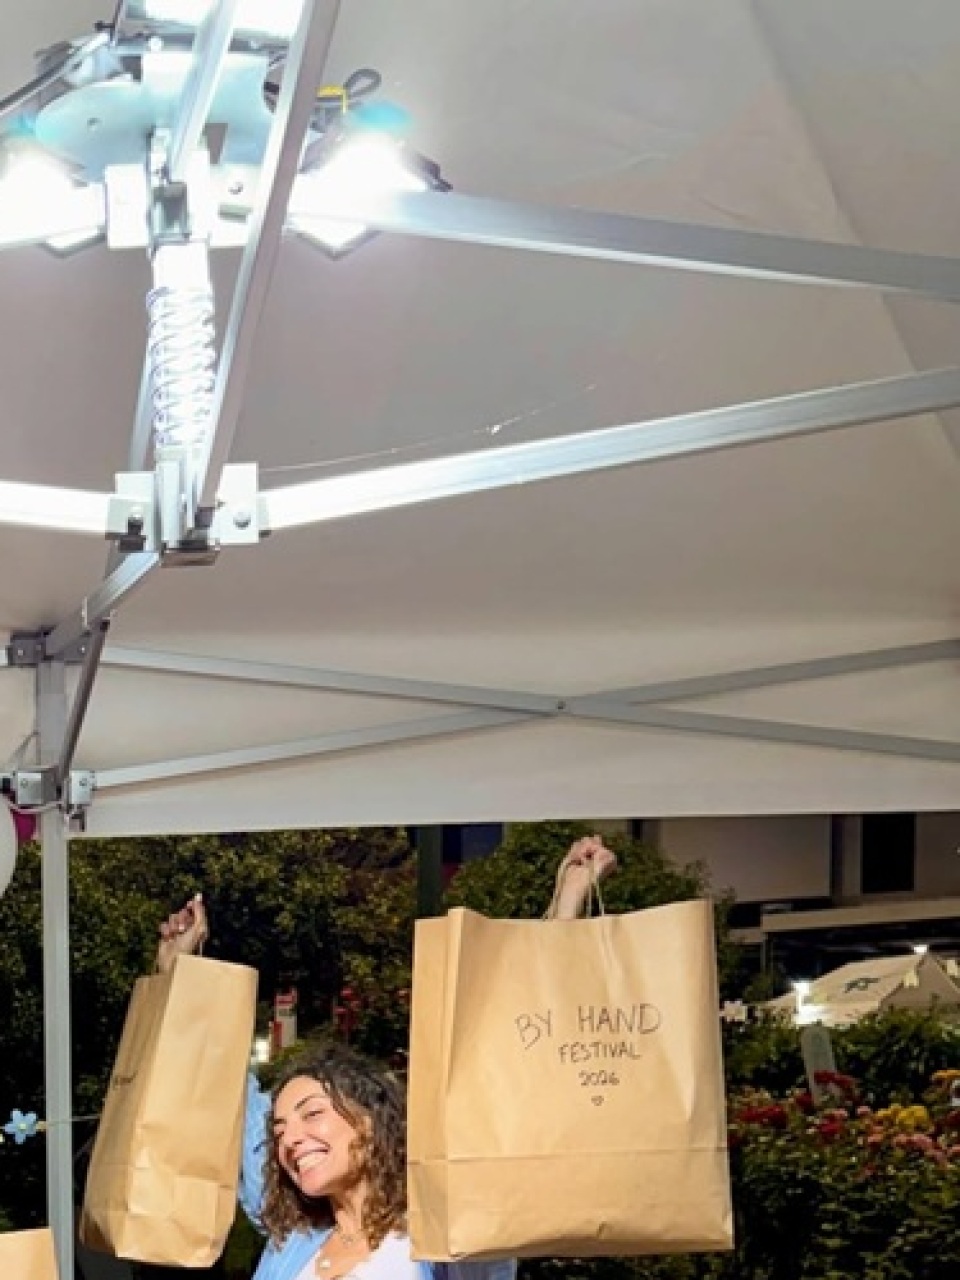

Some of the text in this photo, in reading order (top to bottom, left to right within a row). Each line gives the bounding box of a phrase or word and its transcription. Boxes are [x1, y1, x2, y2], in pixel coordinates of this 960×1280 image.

[514, 1003, 662, 1050] BY HAND
[558, 1041, 642, 1064] FESTIVAL
[578, 1069, 620, 1086] 2026
